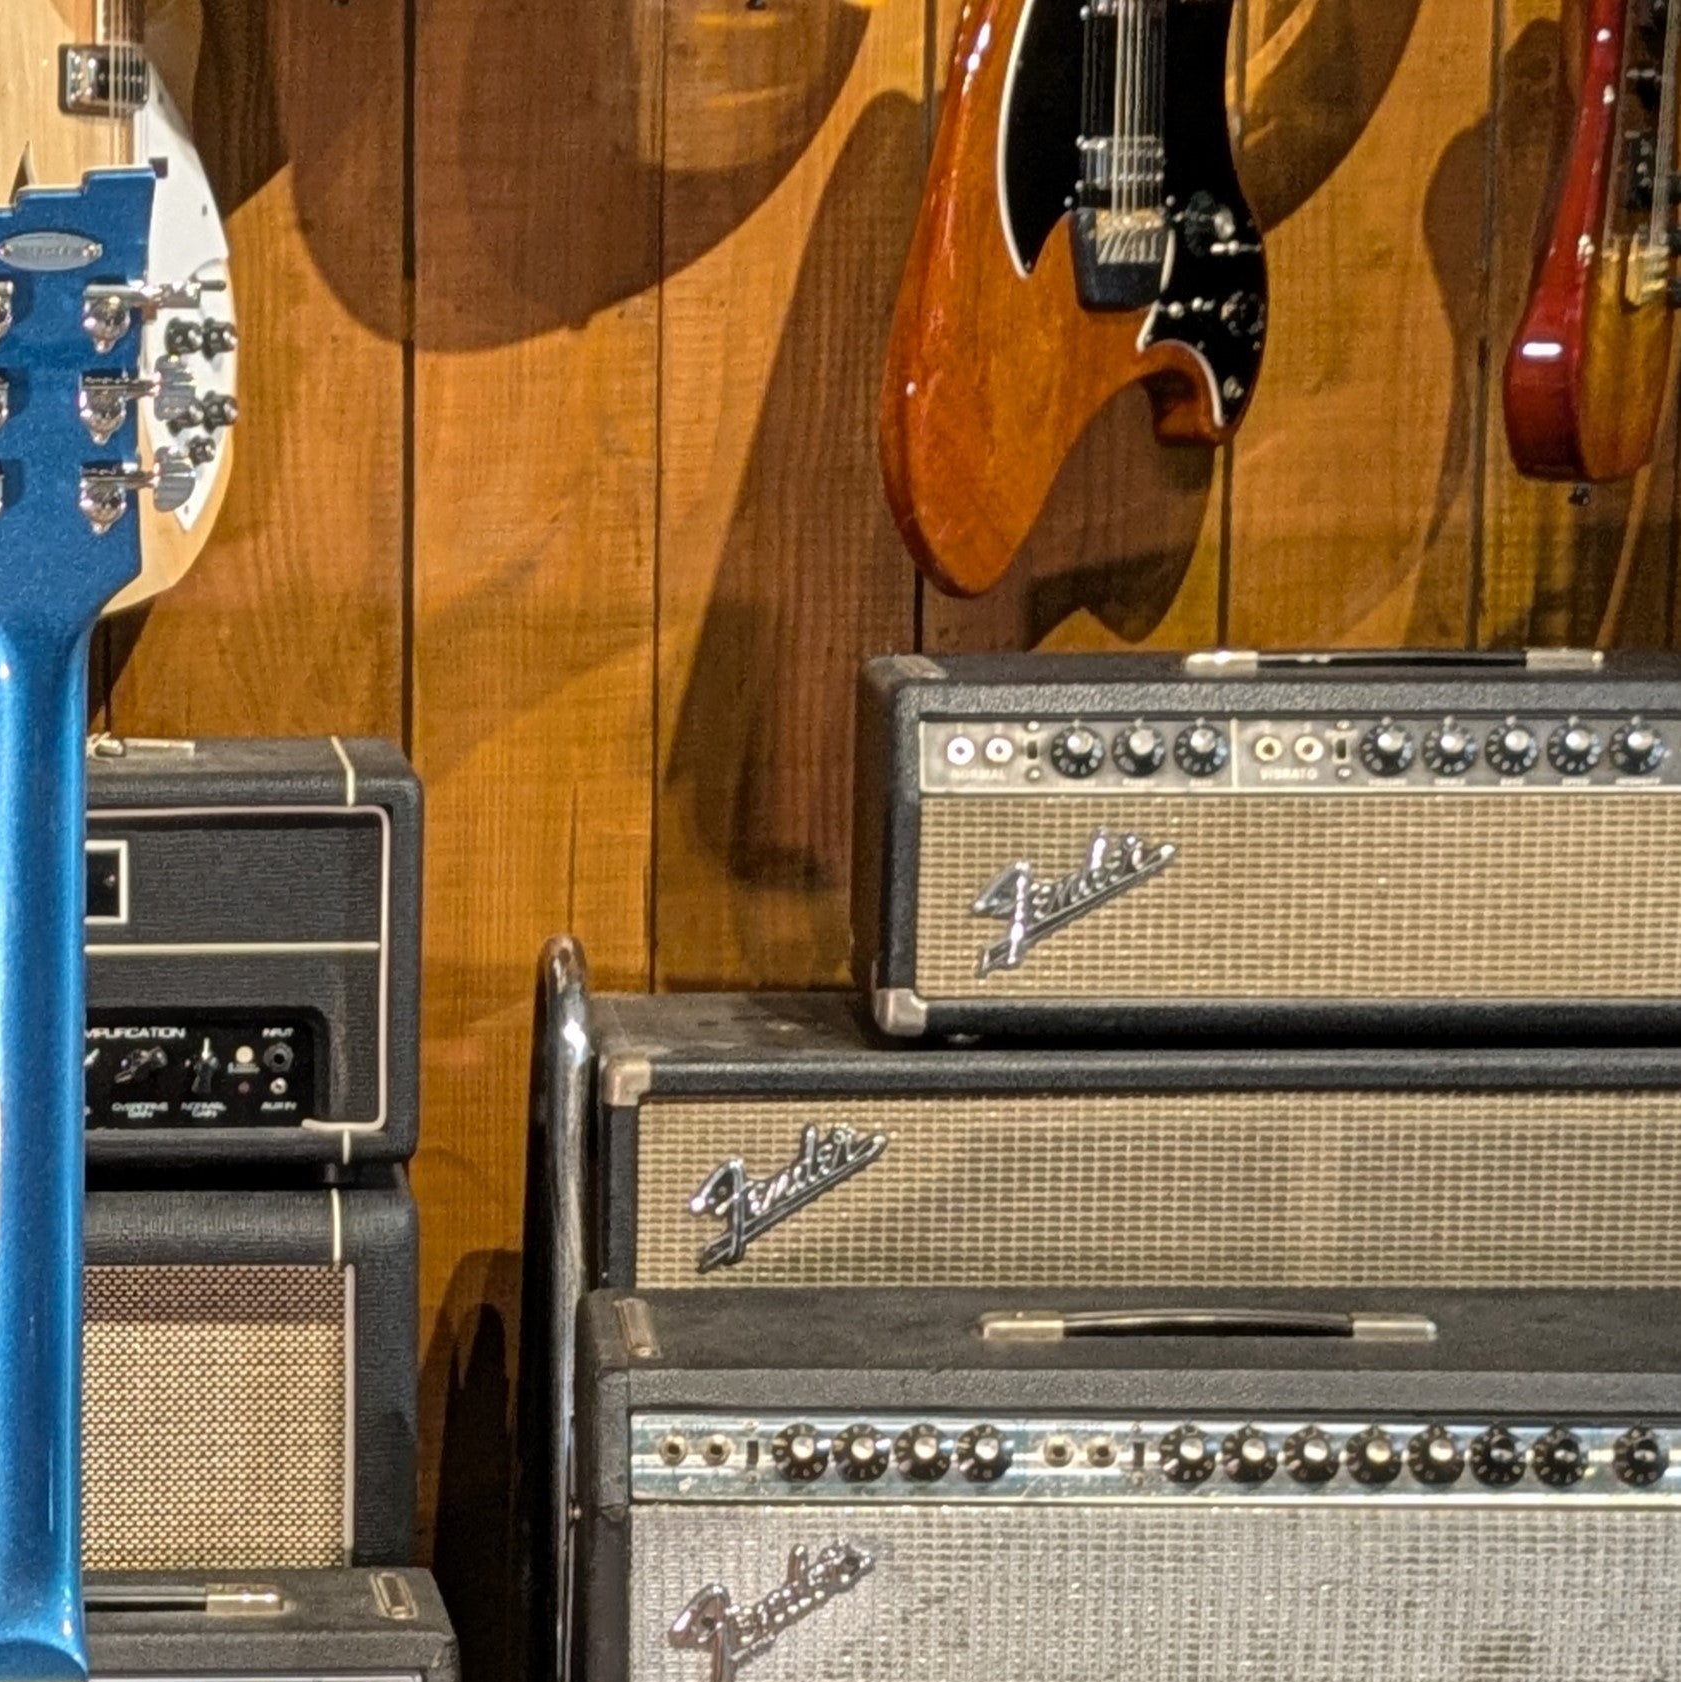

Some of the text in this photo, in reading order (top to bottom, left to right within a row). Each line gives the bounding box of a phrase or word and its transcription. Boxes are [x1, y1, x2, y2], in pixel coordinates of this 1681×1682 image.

[1260, 767, 1318, 781] VIBRATO
[972, 825, 1176, 979] Fender
[85, 1027, 186, 1040] MPLIFICATION
[689, 1122, 888, 1274] Fender
